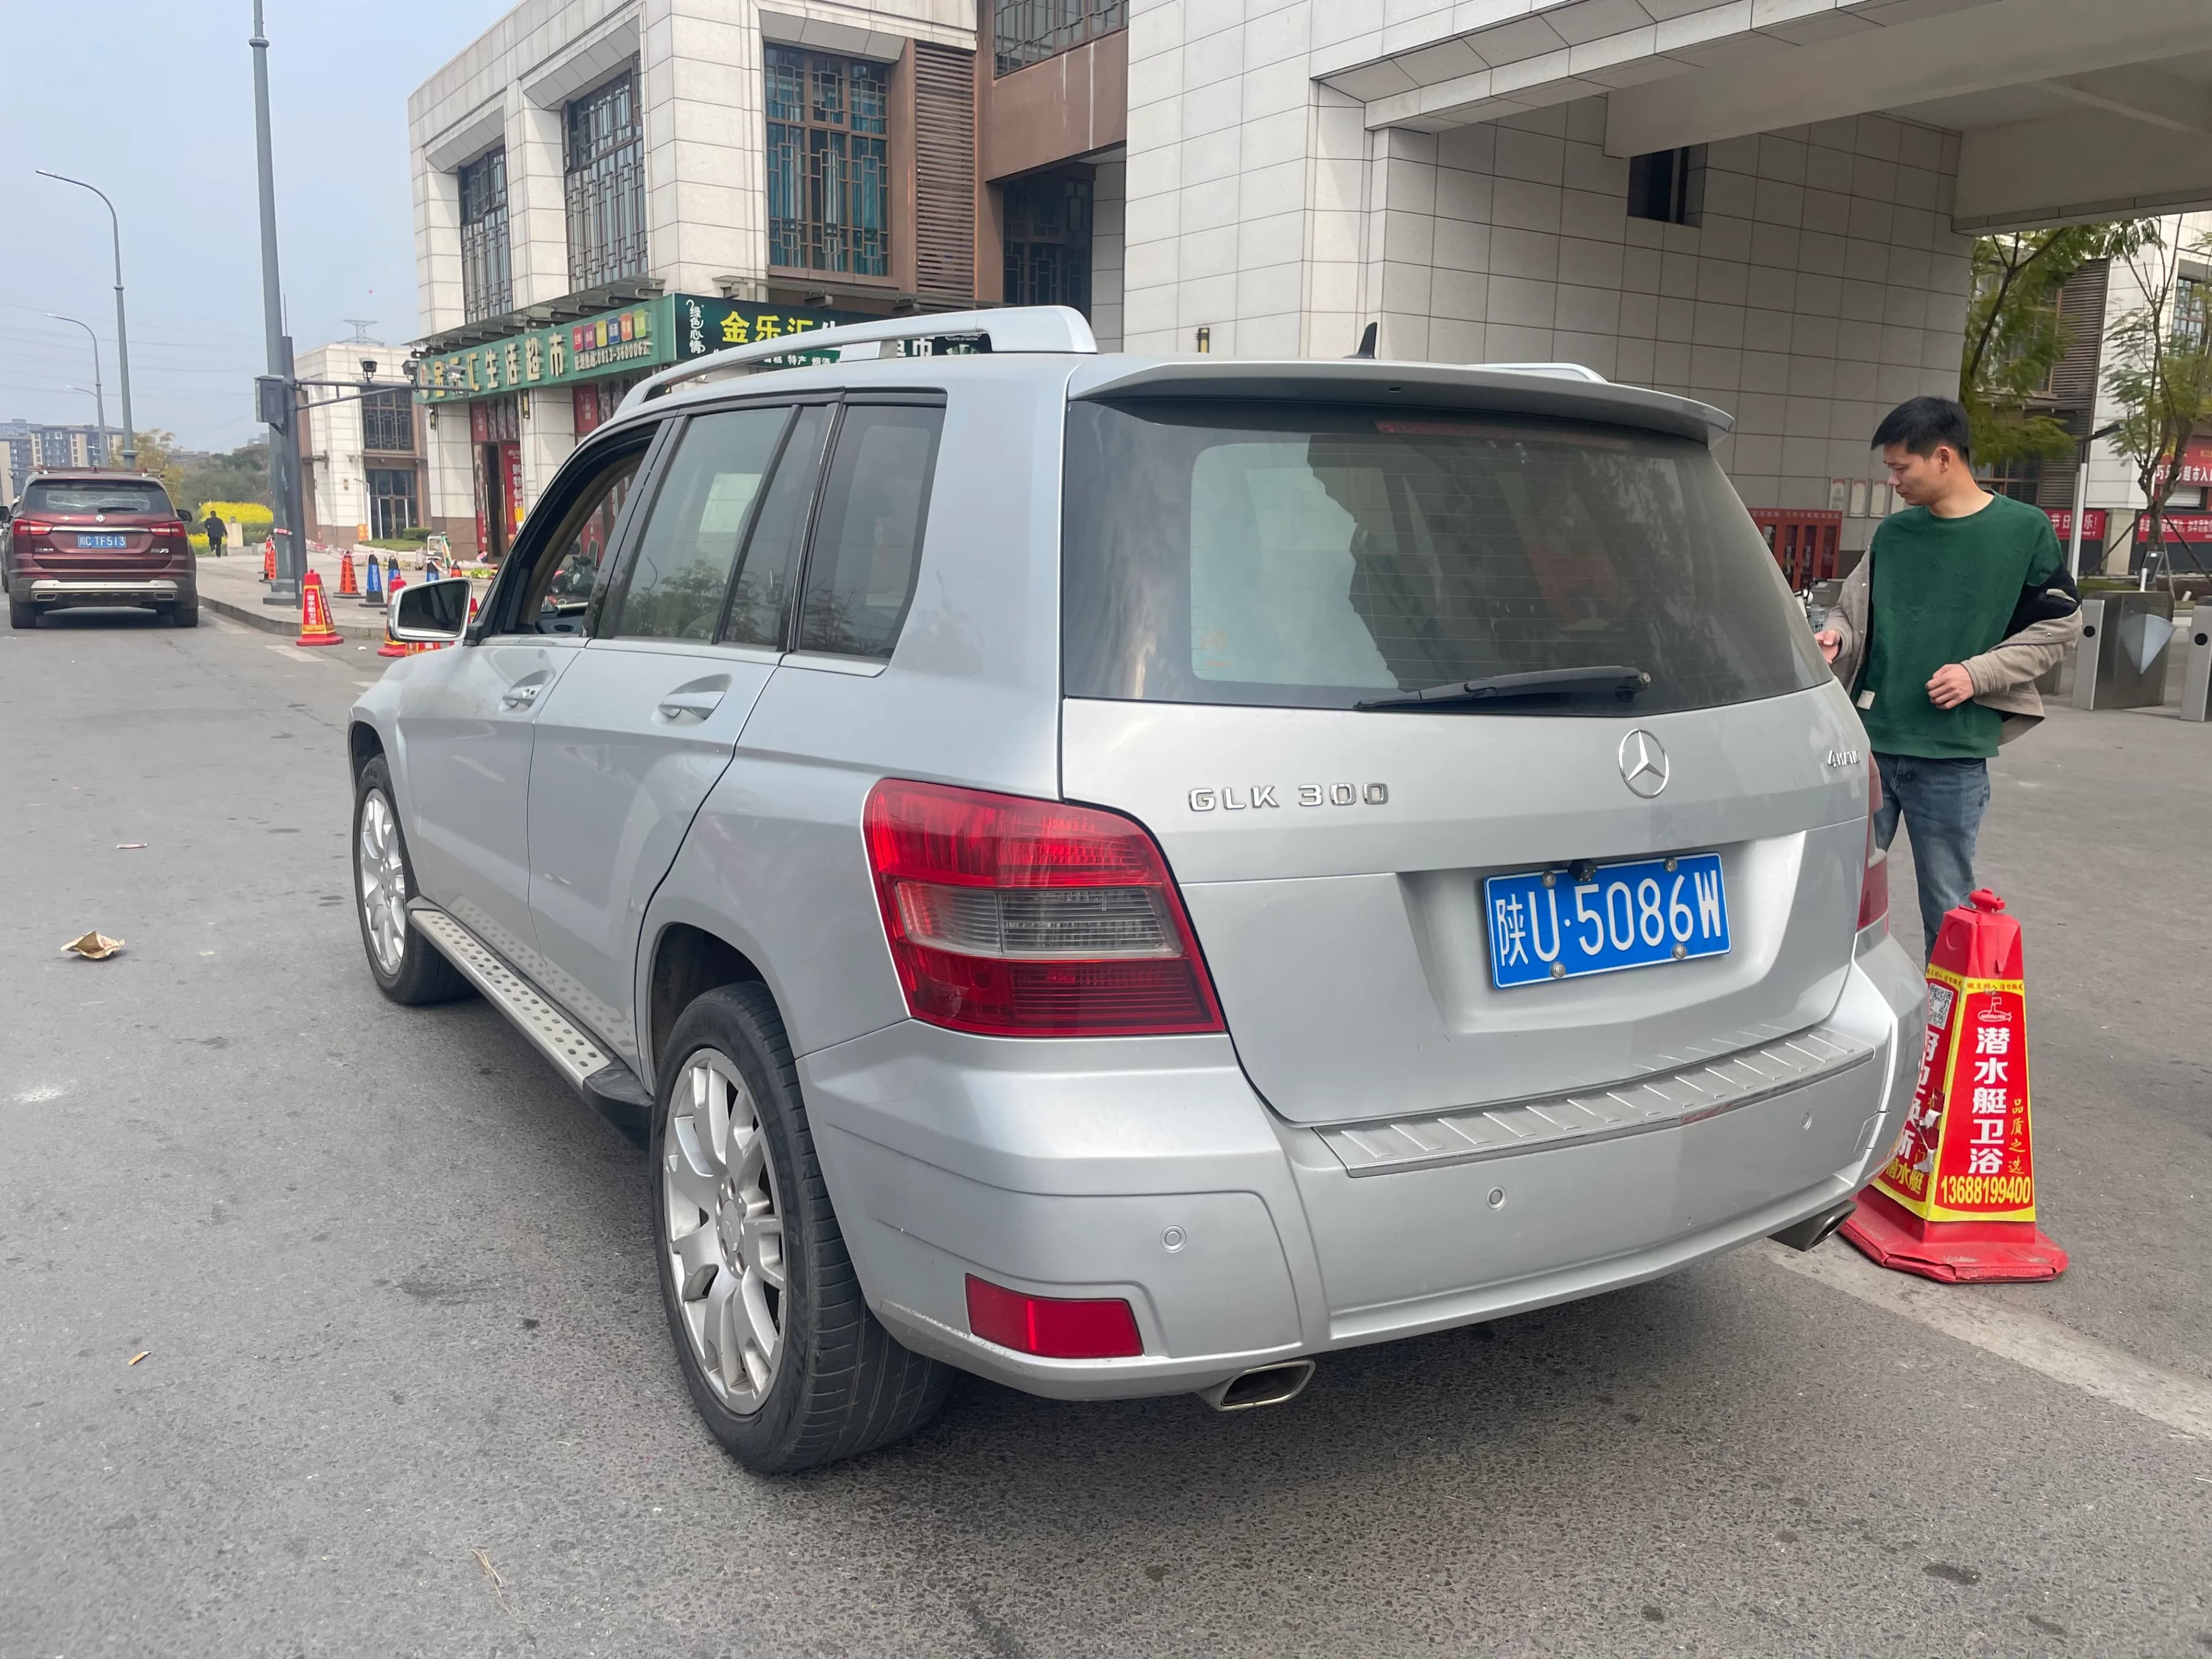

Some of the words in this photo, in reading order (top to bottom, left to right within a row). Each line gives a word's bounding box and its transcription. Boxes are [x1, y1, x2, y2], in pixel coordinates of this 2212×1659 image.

[685, 299, 706, 354] 绿色心情
[720, 310, 836, 344] 金乐汇
[434, 332, 565, 398] 金汇生活超市
[2156, 464, 2212, 482] 巧超市入
[2051, 513, 2098, 530] 节日乐!
[1188, 785, 1281, 812] GLK
[1298, 783, 1389, 806] 300
[1495, 870, 1722, 967] 陕U·5086W
[1967, 1027, 2010, 1175] 潜水艇卫浴
[2008, 1098, 2025, 1175] 品质之选
[1940, 1175, 2031, 1205] 13688199400
